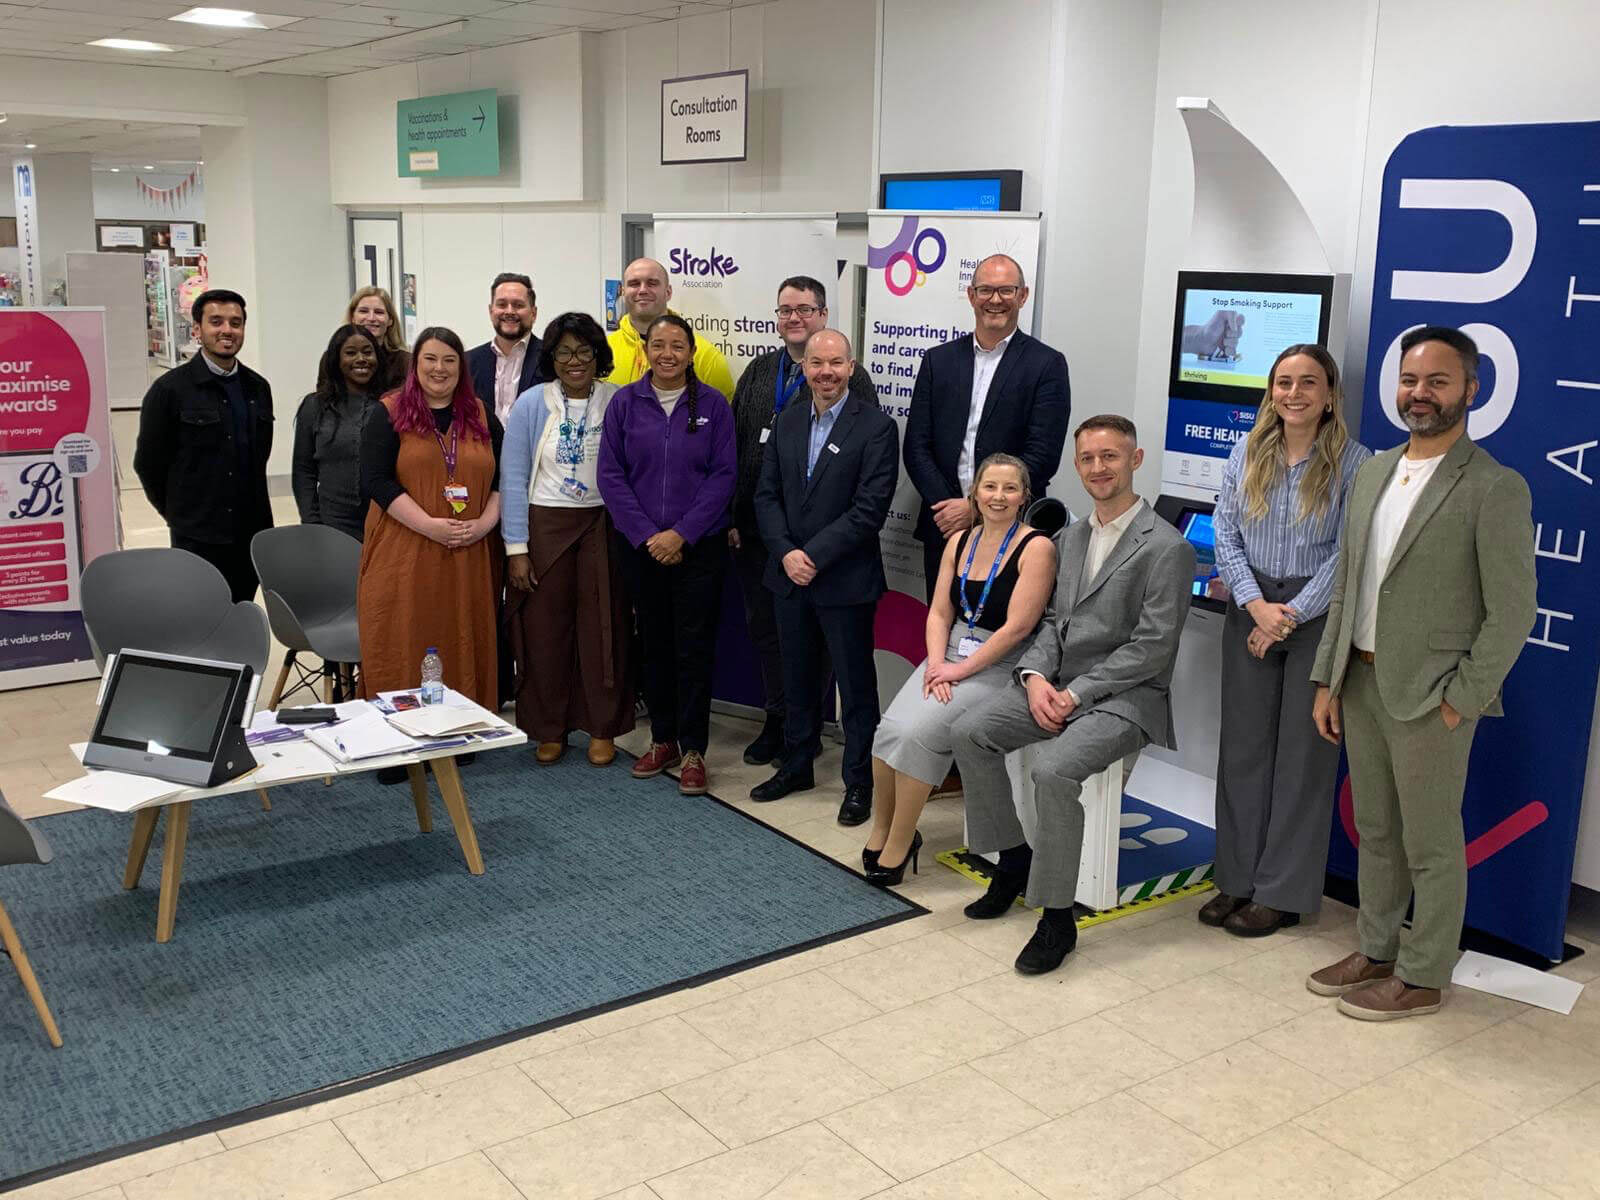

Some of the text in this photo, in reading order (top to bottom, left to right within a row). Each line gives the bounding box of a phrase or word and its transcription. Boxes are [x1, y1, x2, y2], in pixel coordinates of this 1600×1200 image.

[670, 95, 738, 117] Consultation
[408, 111, 441, 124] Vaccinations
[685, 126, 721, 144] Rooms
[669, 247, 739, 277] Stroke
[960, 258, 982, 269] Heal
[682, 279, 723, 289] Association
[1212, 298, 1293, 309] Stop Smoking Support
[681, 313, 782, 338] nding stren
[873, 321, 972, 343] Supporting he
[737, 344, 784, 357] supp
[872, 342, 926, 358] and care
[871, 362, 916, 379] to find,
[1184, 371, 1208, 381] thriving
[873, 382, 893, 396] nd
[10, 428, 25, 437] you
[26, 427, 42, 437] pay
[1185, 423, 1213, 440] FREE
[10, 635, 39, 645] value
[40, 630, 72, 641] today
